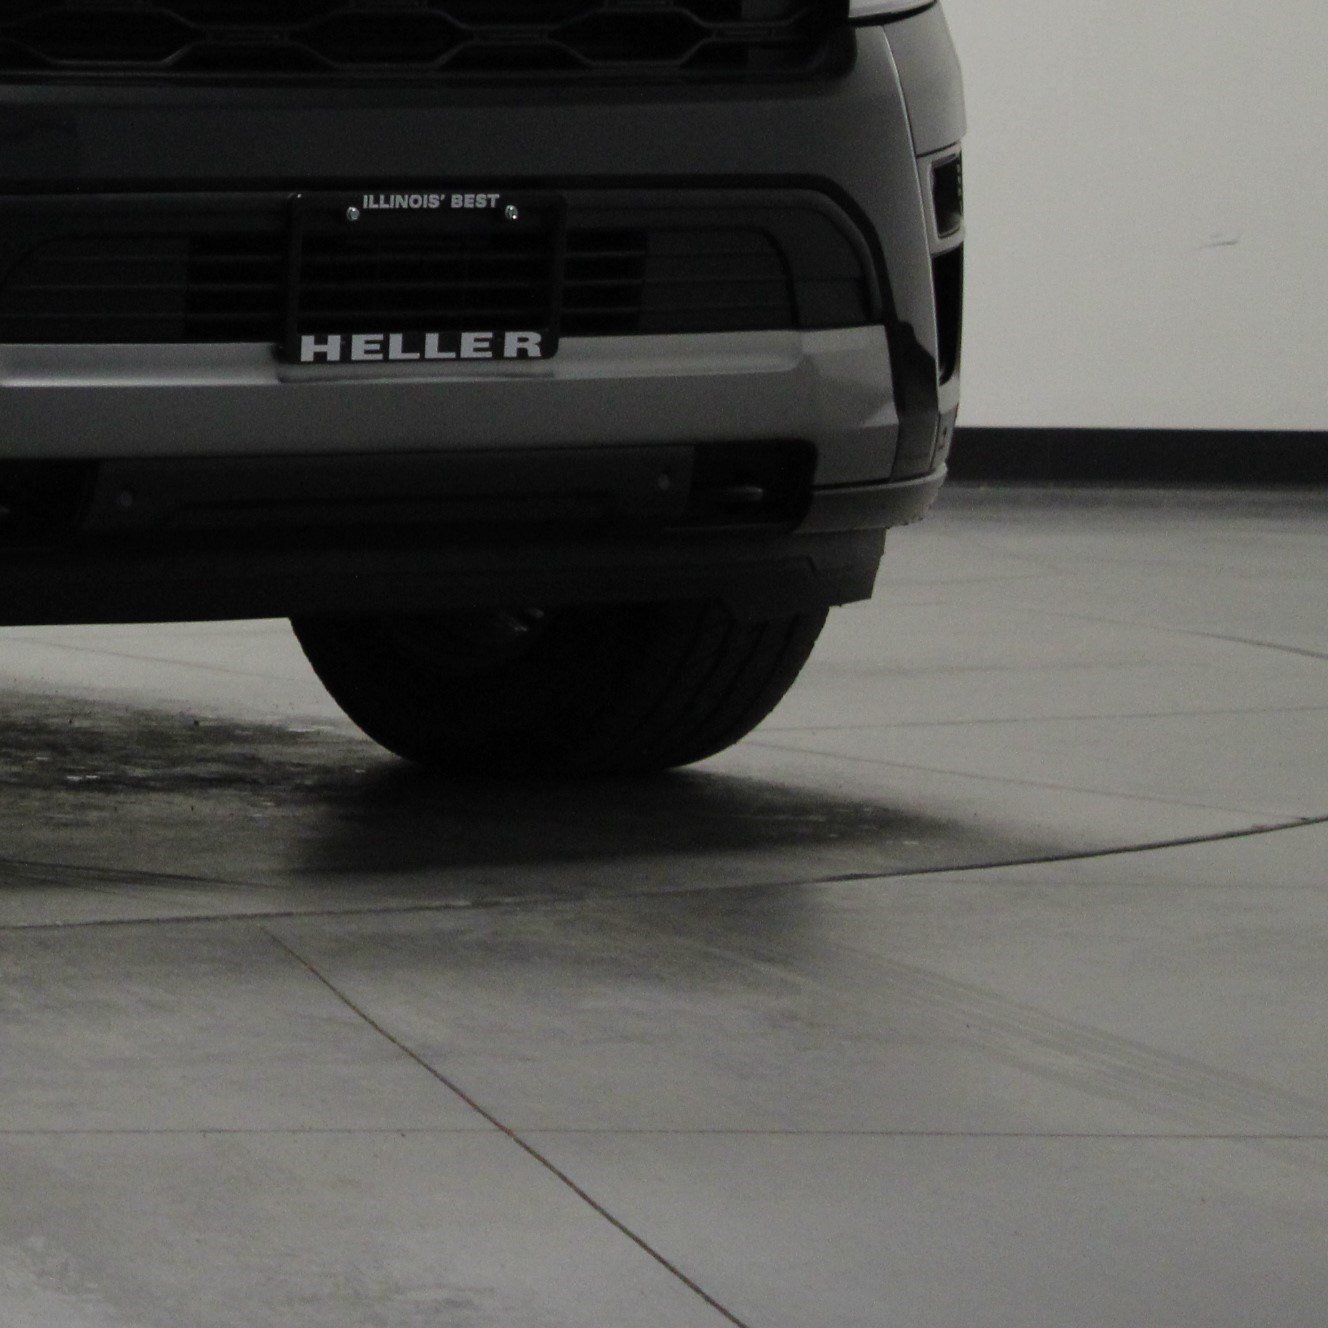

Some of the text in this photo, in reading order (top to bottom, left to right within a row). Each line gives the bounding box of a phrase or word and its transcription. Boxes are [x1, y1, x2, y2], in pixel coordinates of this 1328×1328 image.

[362, 193, 500, 209] ILLINOIS' BEST
[300, 330, 543, 362] HELLER
